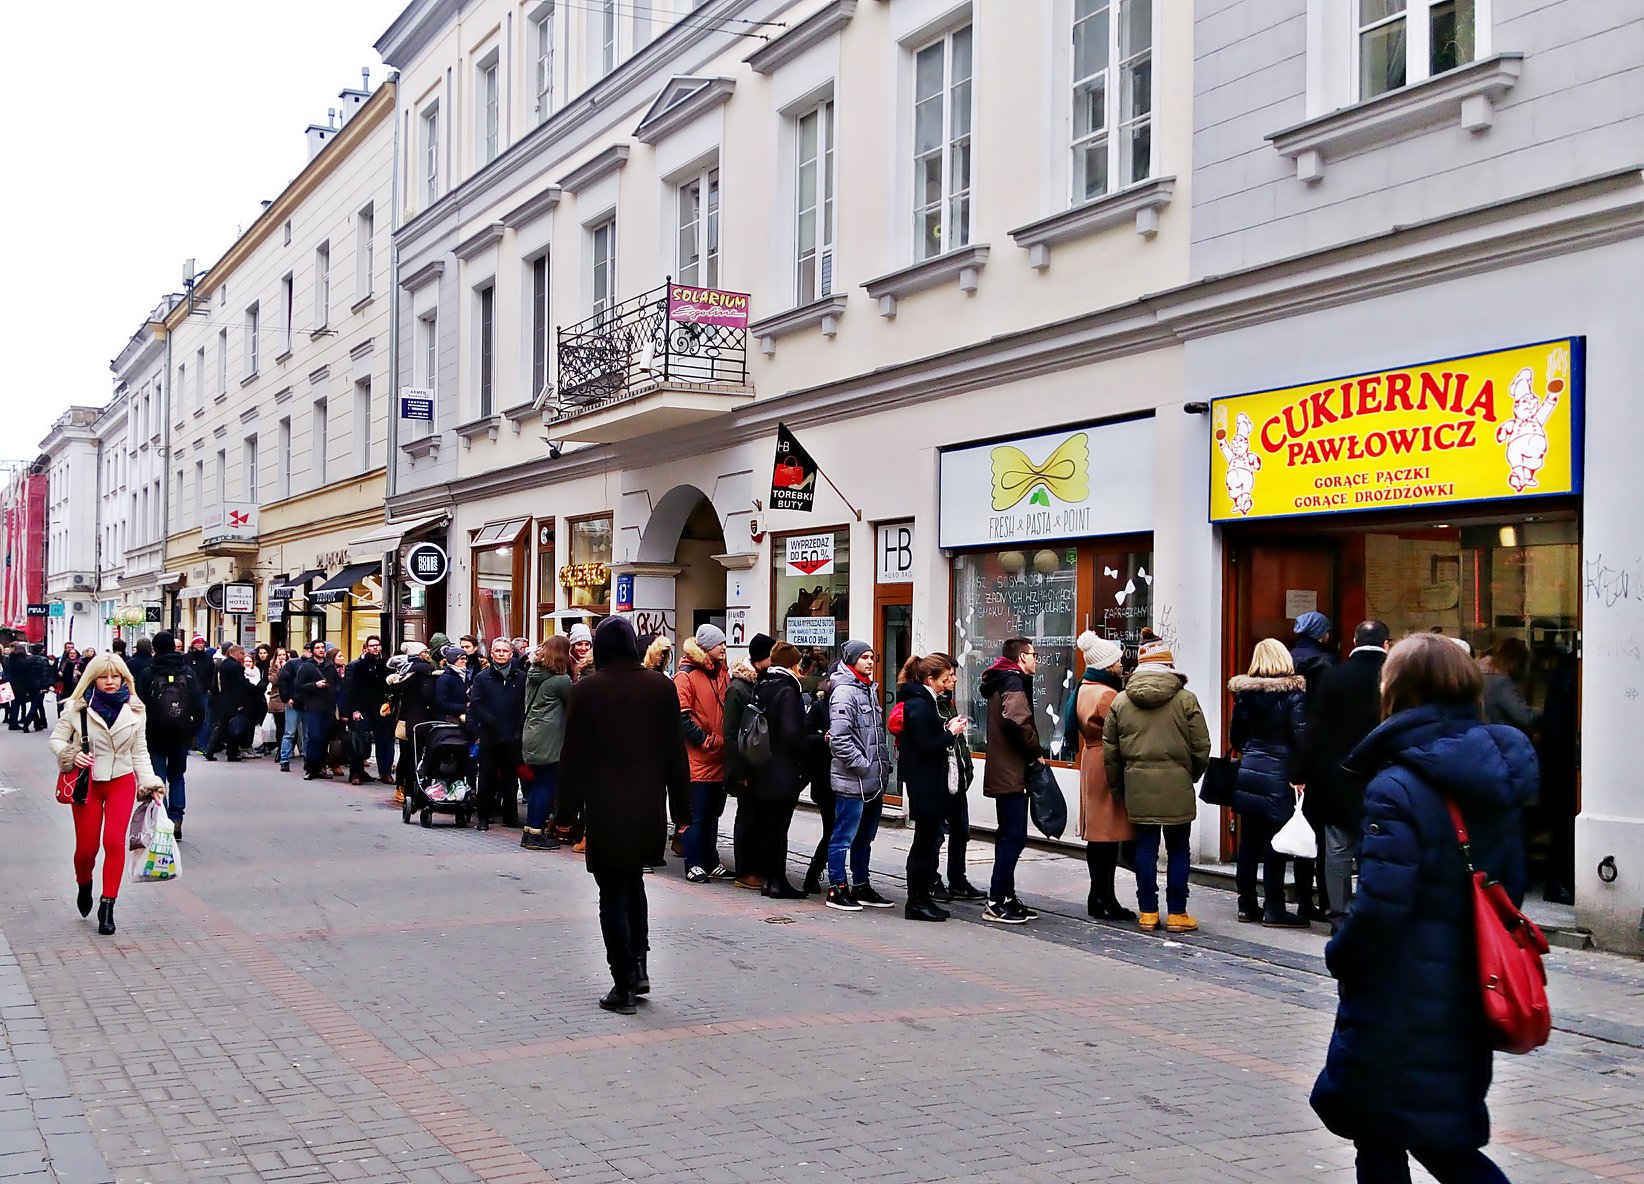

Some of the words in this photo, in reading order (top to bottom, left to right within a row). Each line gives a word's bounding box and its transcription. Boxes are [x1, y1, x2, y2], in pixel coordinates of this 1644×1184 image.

[672, 287, 746, 309] SOLARIUM
[1261, 372, 1497, 453] CUKIERNIA
[777, 441, 790, 452] HB
[1287, 420, 1476, 466] PAWŁOWICZ
[1314, 473, 1370, 489] GORĄCE
[1376, 467, 1430, 485] PĄCZKI
[772, 489, 813, 502] TOREBKI
[777, 500, 803, 509] BUTY
[1294, 493, 1348, 508] GORĄCE
[1355, 483, 1454, 503] DROŻDŻÓWKI
[989, 515, 1015, 538] FRESH
[1026, 512, 1051, 535] PASTA
[1063, 507, 1091, 532] POINT
[790, 551, 800, 561] DO
[801, 549, 819, 569] 50
[885, 527, 912, 572] HB
[1103, 605, 1148, 619] ZAPRASZAMY
[793, 635, 807, 644] CENA
[1105, 627, 1134, 641] FRESH
